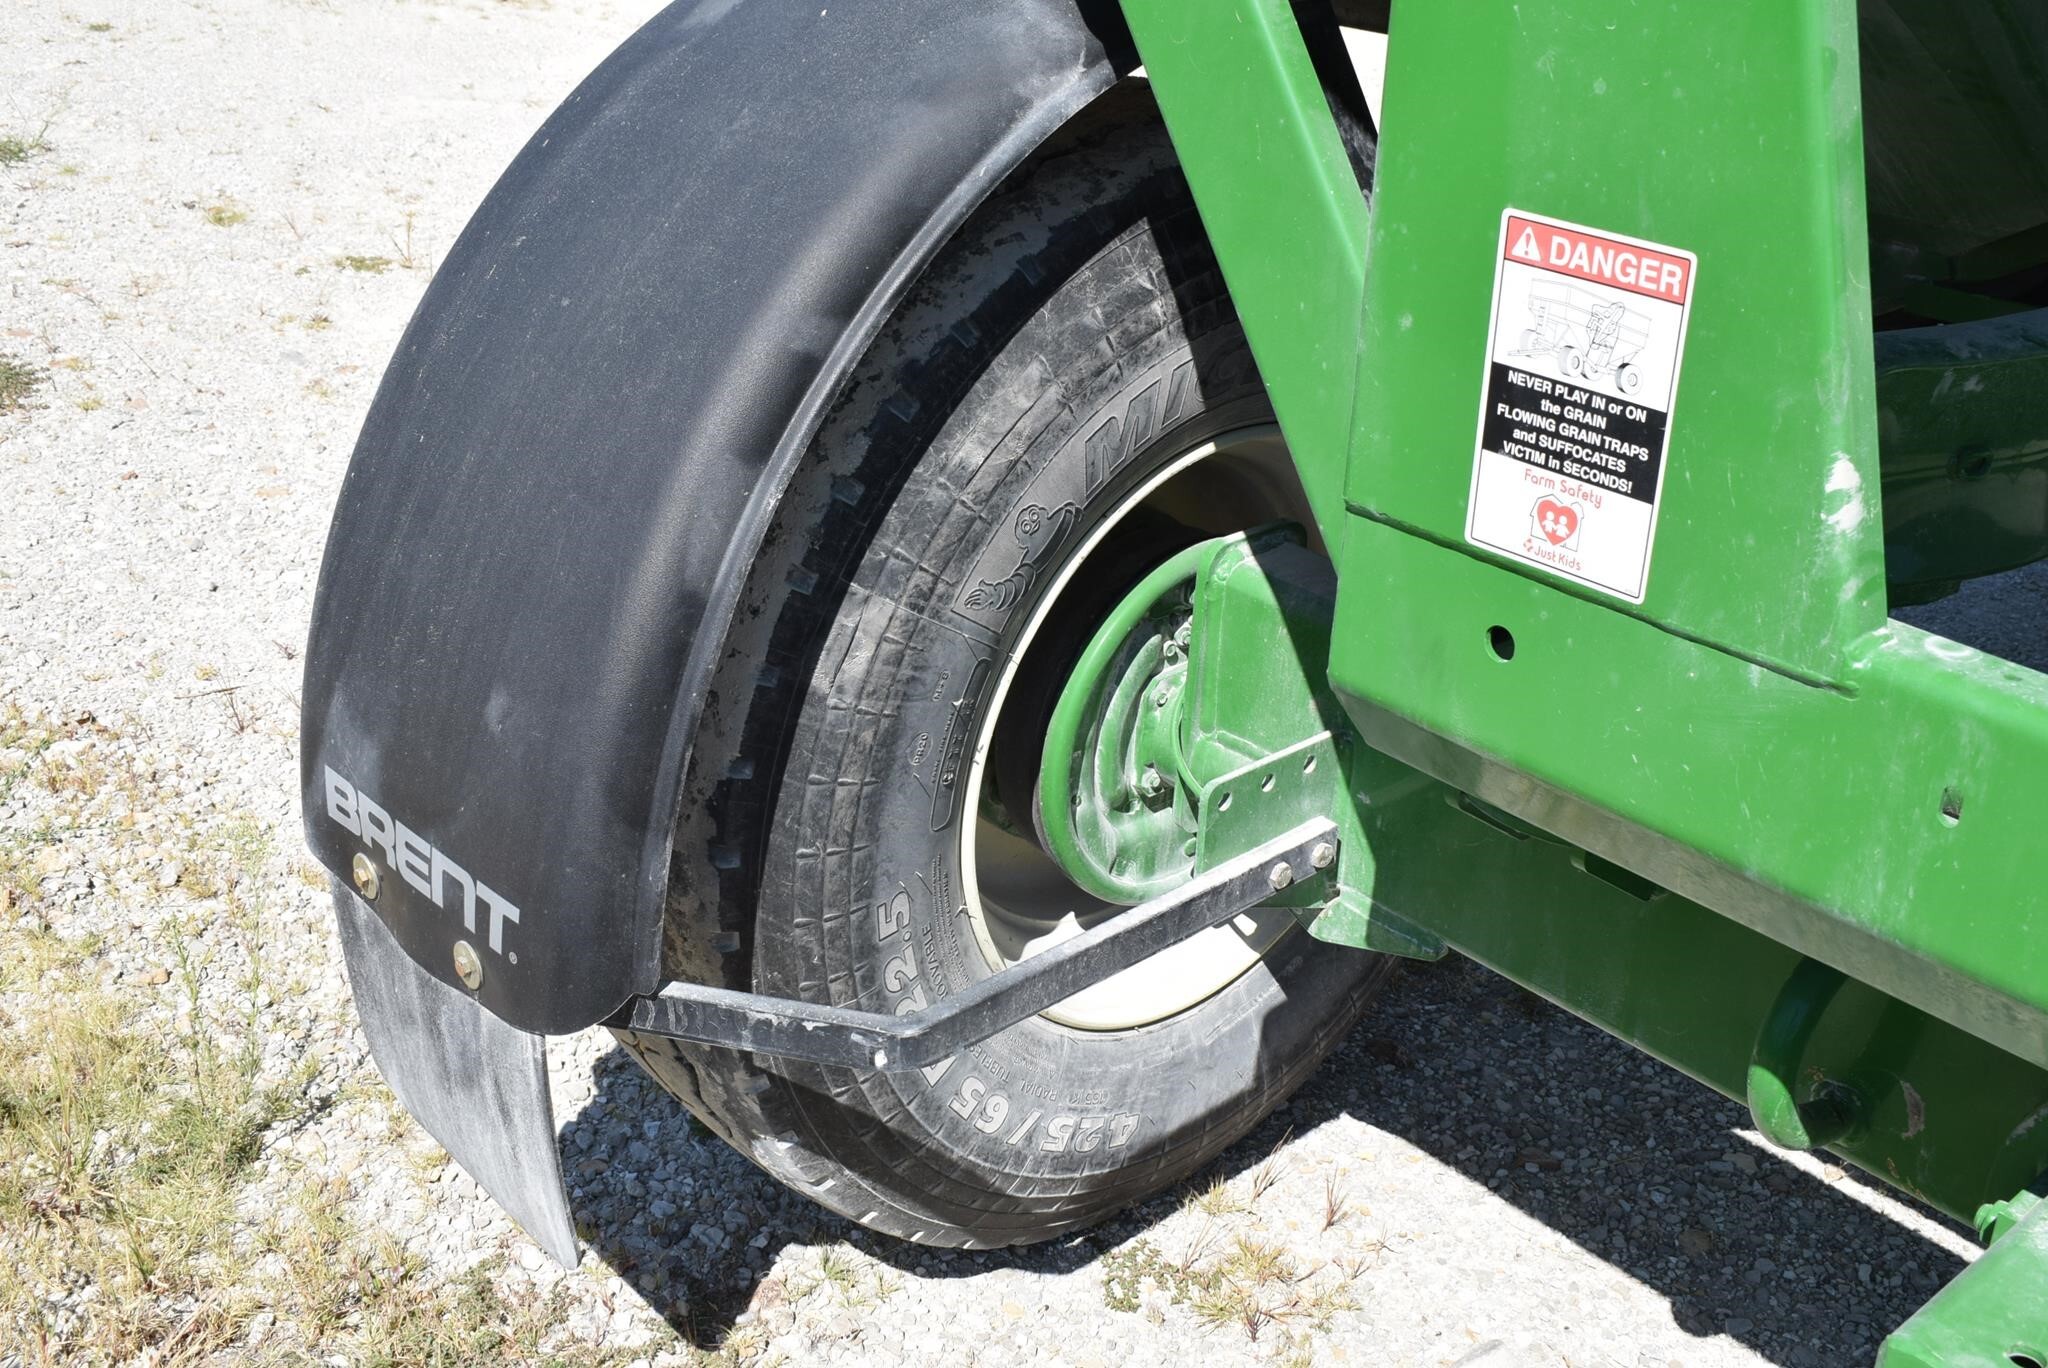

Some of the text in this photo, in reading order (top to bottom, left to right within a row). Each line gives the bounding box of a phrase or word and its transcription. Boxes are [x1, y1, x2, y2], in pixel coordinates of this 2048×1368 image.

[1549, 235, 1683, 296] DANGER
[1508, 370, 1647, 423] NEVER PLAY IN or ON
[1541, 399, 1607, 430] the GRAIN
[1496, 403, 1649, 462] FLOWING GRAIN TRAPS
[1512, 428, 1627, 473] and SUFFOCATES
[1502, 440, 1633, 494] VICTIM in SECONDS!
[1524, 468, 1602, 509] Farm Safety
[1534, 545, 1557, 562] Just
[1558, 552, 1582, 571] Kids
[324, 764, 521, 956] BRENT
[1019, 1078, 1059, 1102] RADIAL
